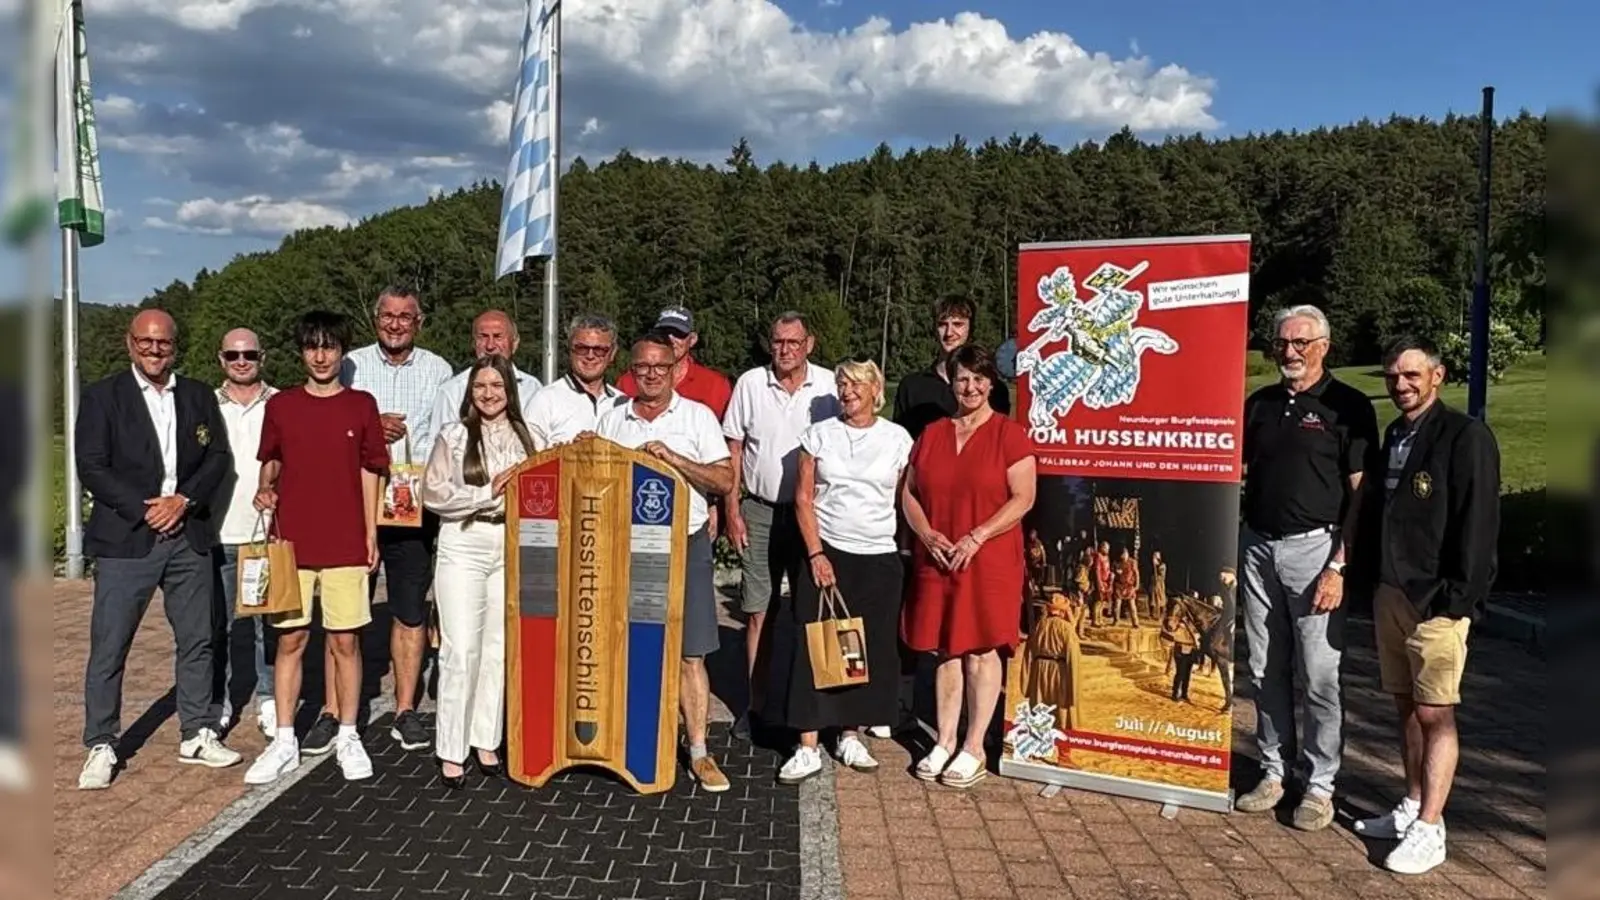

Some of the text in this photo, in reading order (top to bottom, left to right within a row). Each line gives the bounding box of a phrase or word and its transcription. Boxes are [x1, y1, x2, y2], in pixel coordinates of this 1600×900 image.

[1152, 281, 1218, 294] Wir wünschen
[1152, 288, 1240, 306] gute Unterhaltung!
[1119, 415, 1236, 426] Neunburger Burgfestspiele
[1074, 429, 1236, 449] HUSSENKRIEG
[1093, 460, 1133, 468] JOHANN
[1135, 461, 1157, 469] UND
[1159, 462, 1180, 470] DEN
[1182, 463, 1234, 473] HUSSITEN
[645, 498, 661, 509] 40
[574, 495, 601, 711] Hussittenschild
[1115, 716, 1144, 731] Juli
[1165, 723, 1222, 742] August
[1069, 736, 1222, 765] www.burgfestspiele-neunburg.de
